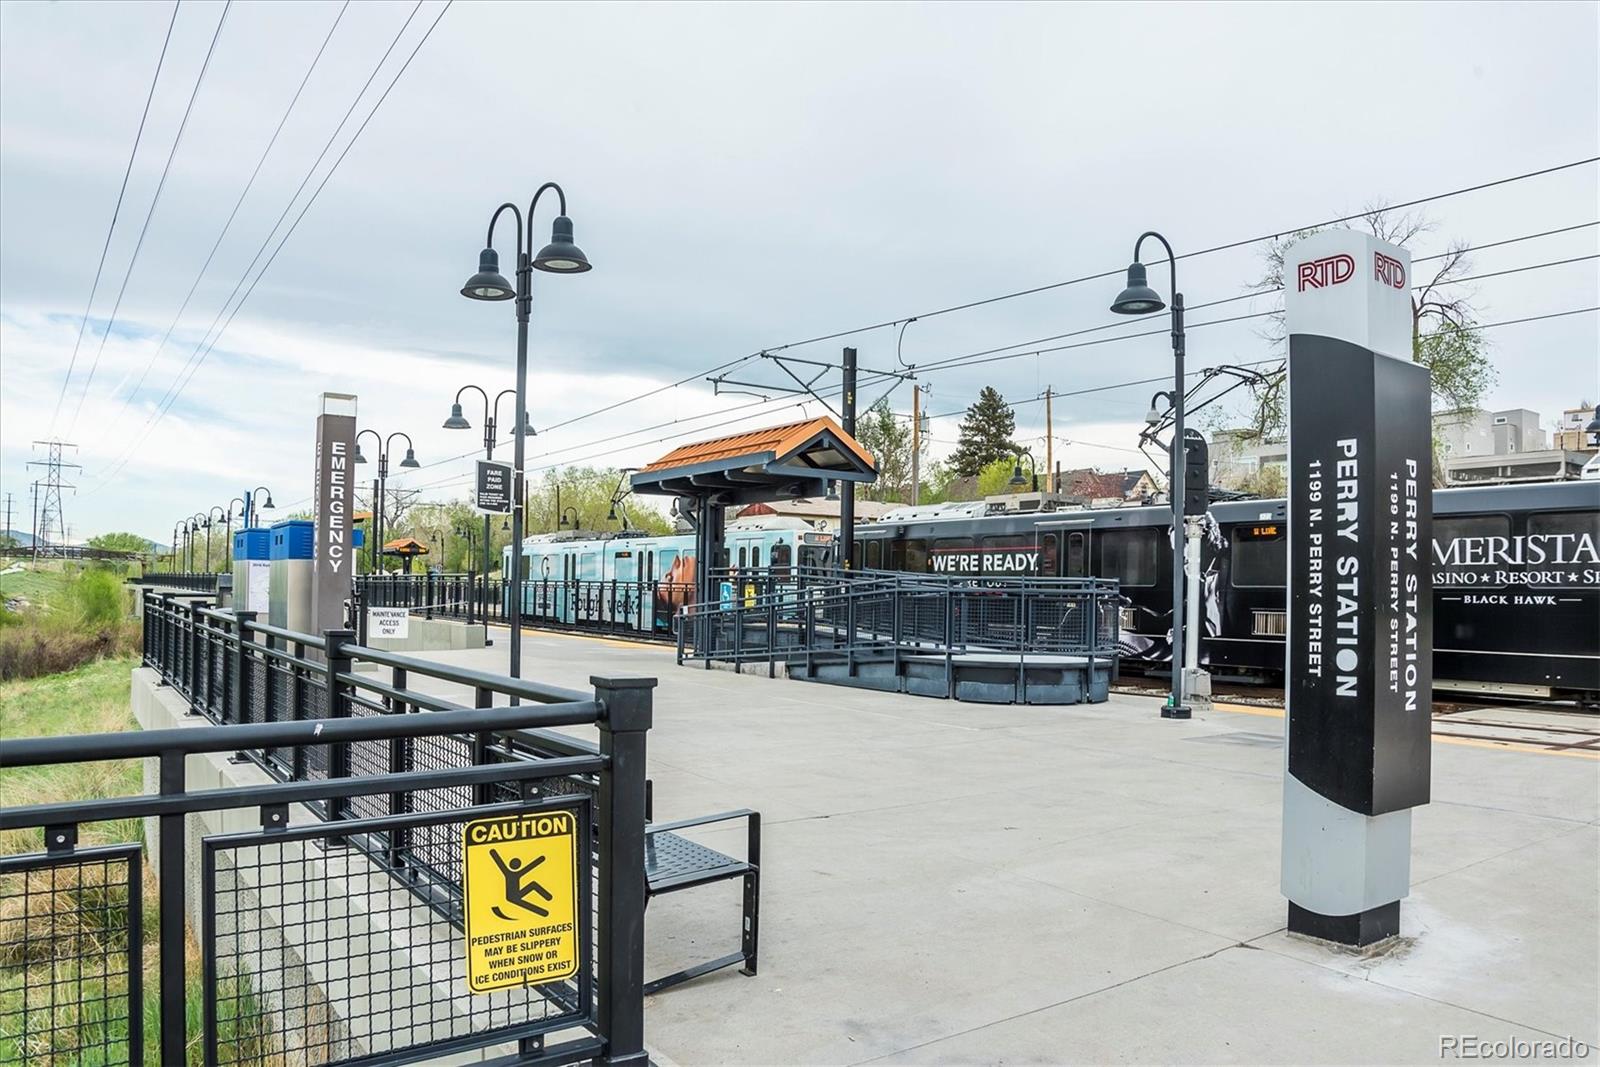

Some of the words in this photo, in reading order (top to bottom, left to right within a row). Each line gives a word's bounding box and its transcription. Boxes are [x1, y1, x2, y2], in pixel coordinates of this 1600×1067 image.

[1298, 254, 1355, 292] RTD
[1374, 251, 1406, 289] RTD
[486, 469, 503, 477] FARE
[1309, 460, 1322, 501] 1199
[1337, 438, 1359, 542] PERRY
[328, 441, 346, 573] EMERGENCY
[1390, 472, 1399, 515] 1199
[1405, 458, 1418, 561] PERRY
[1309, 508, 1322, 527] N.
[1390, 521, 1399, 540] N.
[932, 554, 979, 572] WE'RE
[982, 553, 1039, 572] READY.
[1309, 533, 1322, 598] PERRY
[1390, 547, 1399, 612] PERRY
[1463, 595, 1509, 605] BLACK
[1514, 595, 1557, 605] HAWK
[1309, 603, 1322, 677] STREET
[1336, 556, 1359, 697] STATION
[1405, 574, 1418, 711] STATION
[1390, 618, 1399, 693] STREET
[471, 816, 568, 843] CAUTION
[472, 929, 527, 946] PEDESTRIAN
[529, 923, 573, 937] SURFACES
[484, 947, 504, 957] MAY
[506, 944, 518, 954] BE
[520, 937, 562, 951] SLIPPERY
[475, 974, 490, 985] ICE
[492, 967, 545, 982] CONDITIONS
[547, 960, 572, 972] EXIST
[489, 958, 515, 969] WHEN
[517, 953, 543, 965] SNOW
[545, 950, 558, 960] OR
